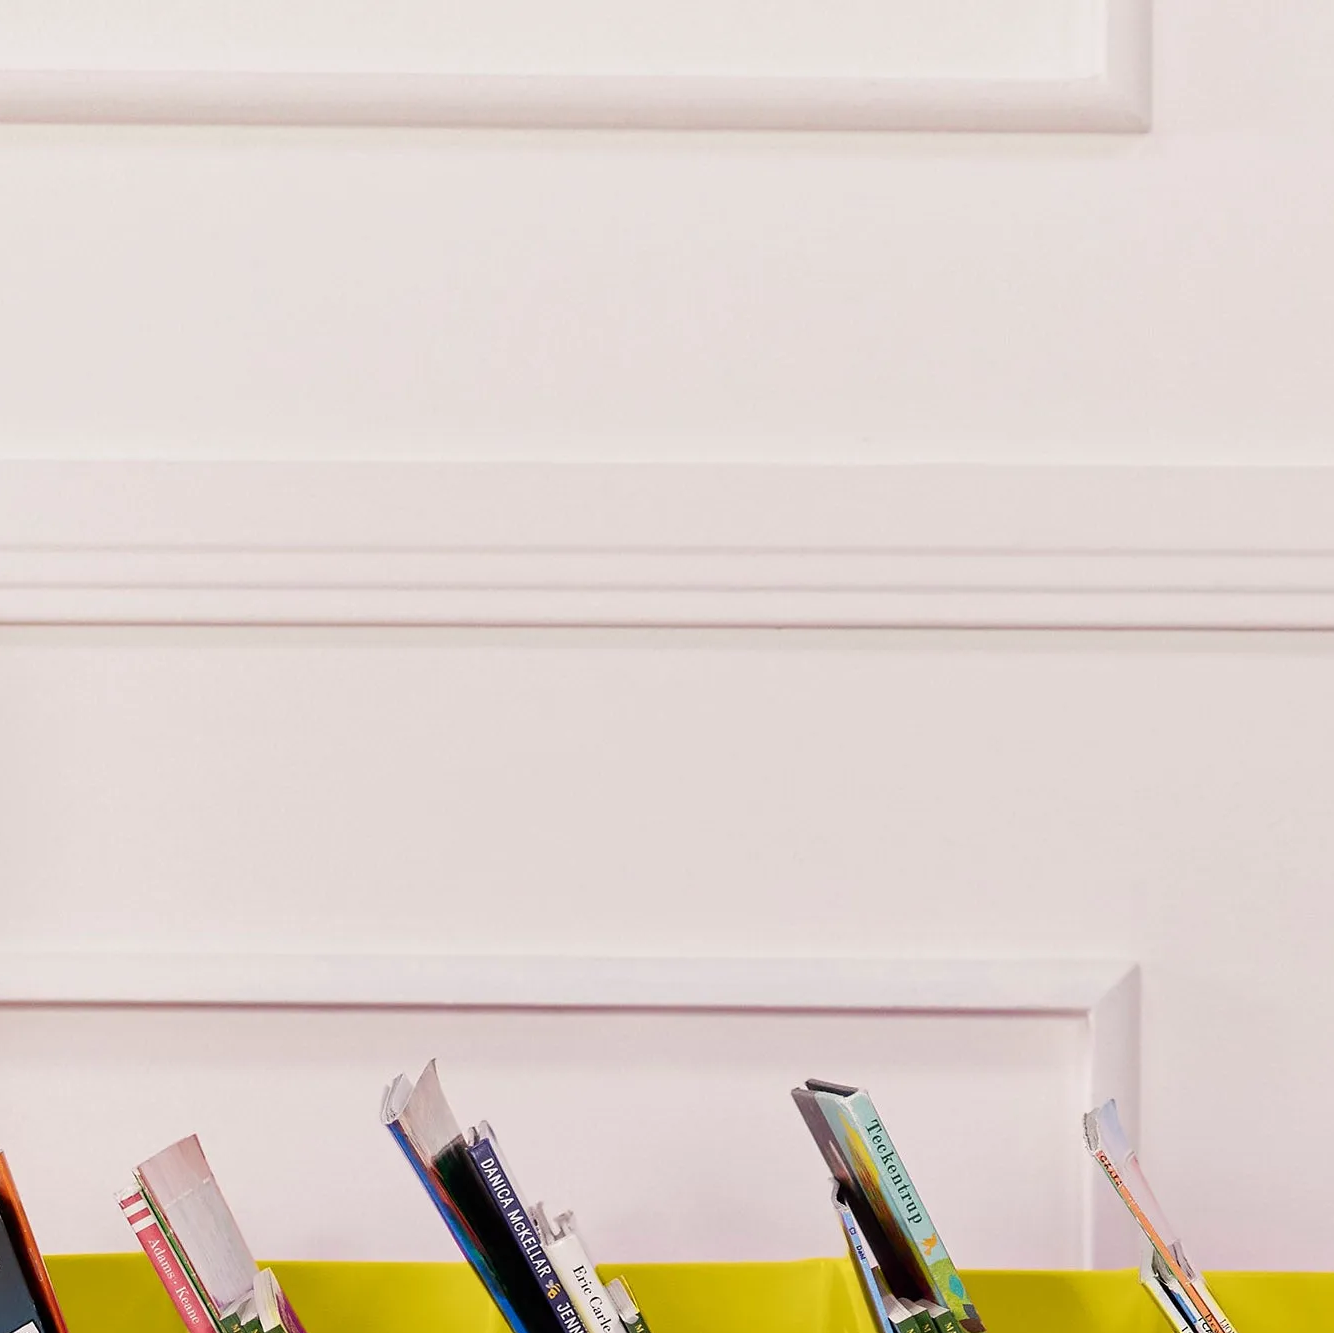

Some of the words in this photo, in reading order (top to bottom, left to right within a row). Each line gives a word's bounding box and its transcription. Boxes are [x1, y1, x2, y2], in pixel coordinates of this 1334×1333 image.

[480, 1157, 515, 1209] DANICA
[507, 1208, 552, 1278] McKELLAR
[865, 1119, 924, 1225] Teckentrup
[148, 1238, 174, 1280] Adams
[175, 1286, 199, 1325] Keane
[572, 1264, 592, 1297] Eric
